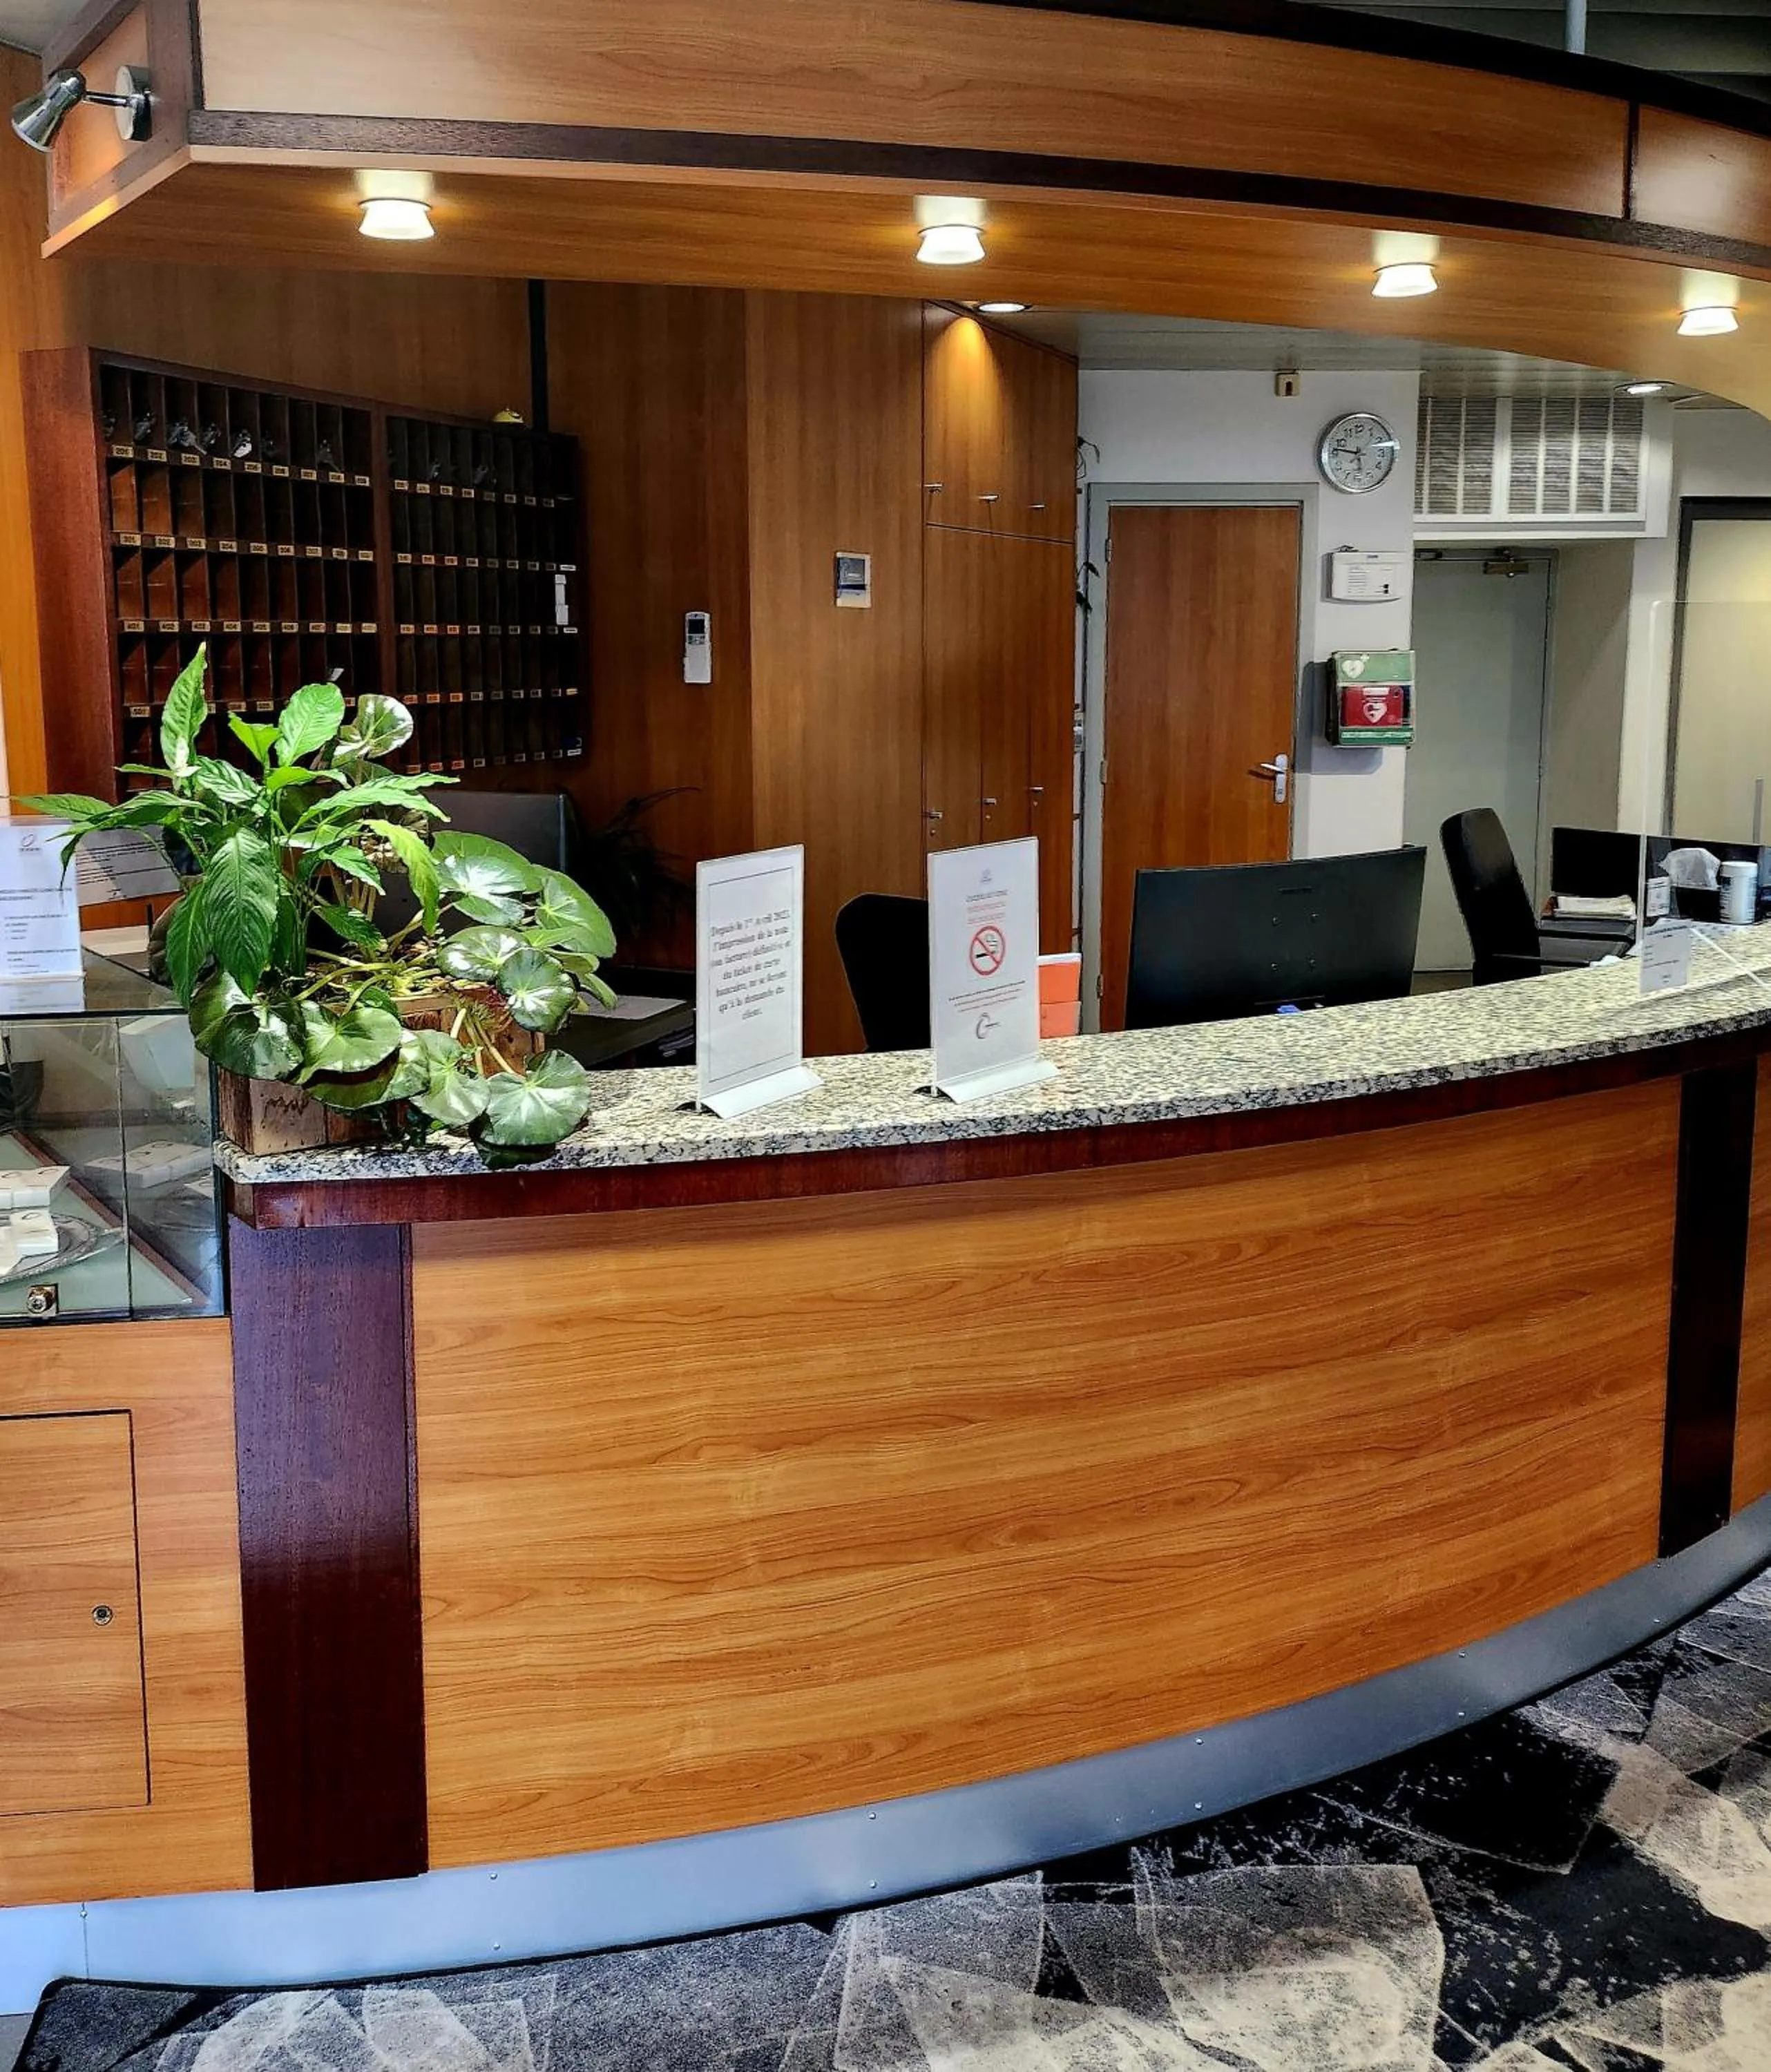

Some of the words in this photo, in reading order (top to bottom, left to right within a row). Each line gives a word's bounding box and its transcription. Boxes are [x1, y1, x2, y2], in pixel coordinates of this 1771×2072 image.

[1343, 428, 1352, 437] 11
[1354, 425, 1363, 434] 12
[1337, 439, 1346, 448] 10
[1377, 449, 1384, 457] 3
